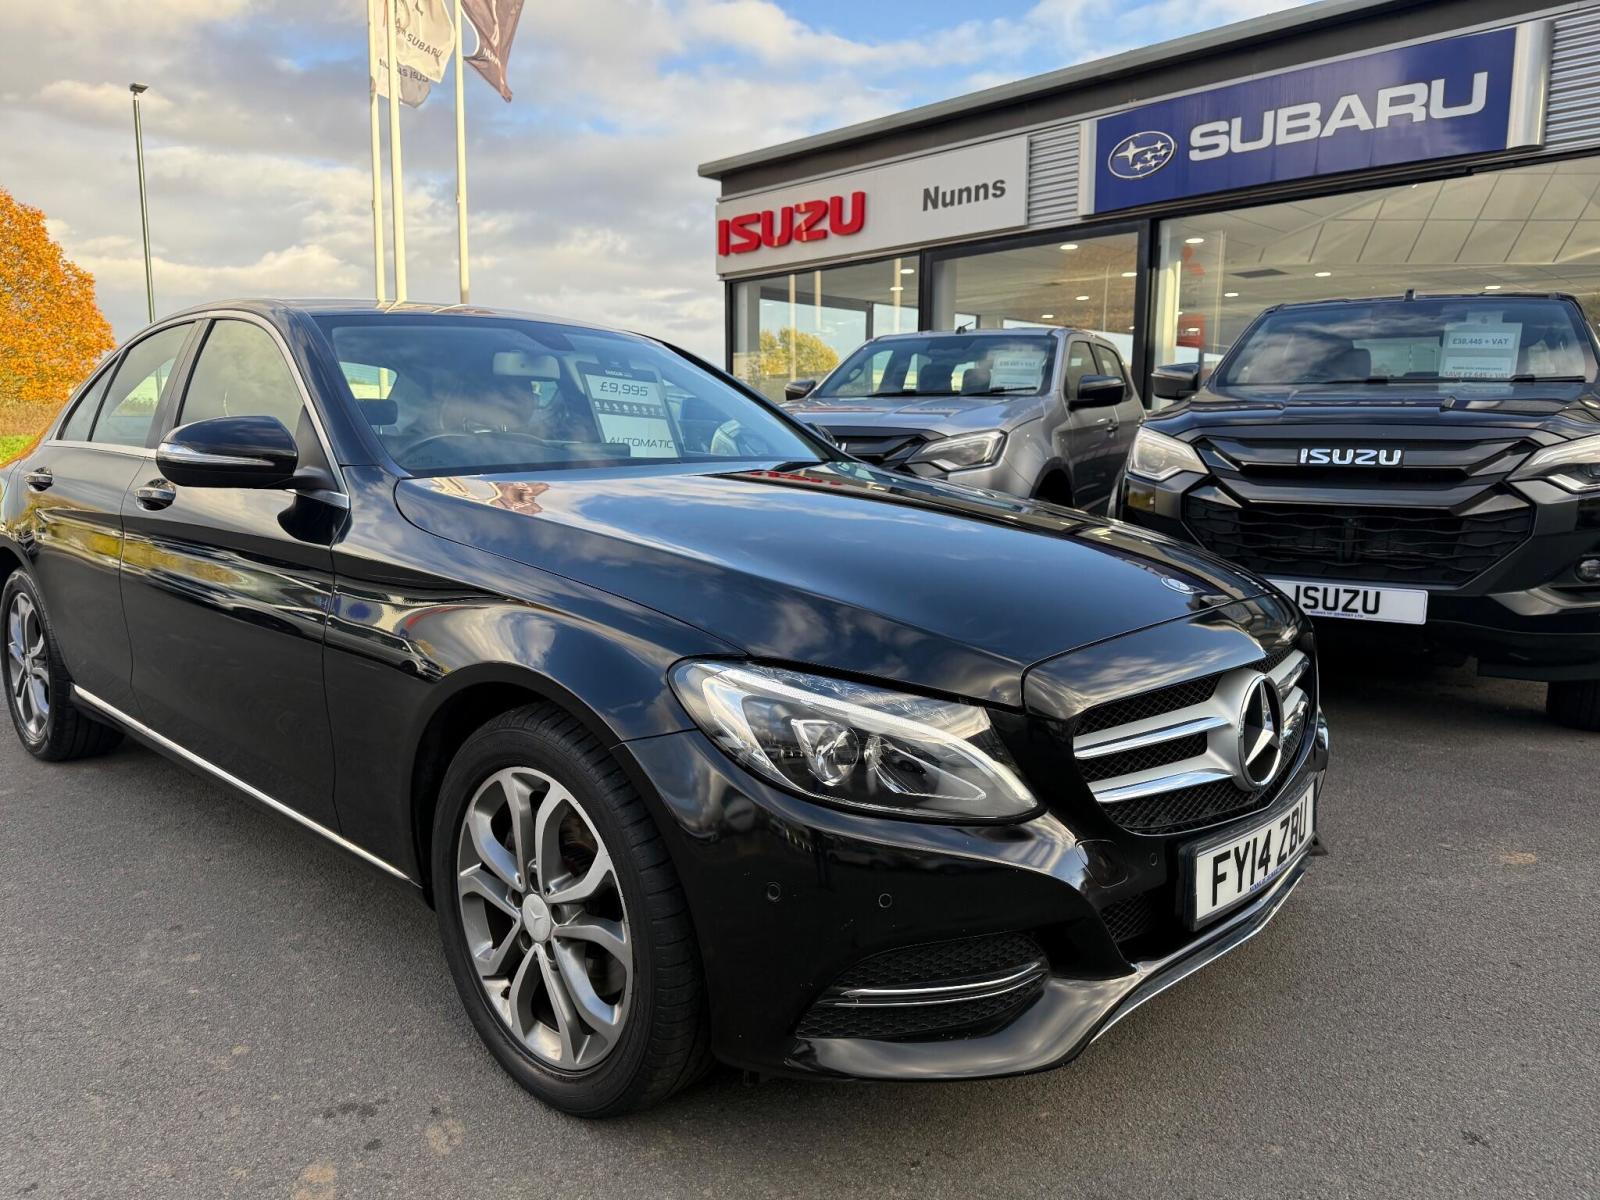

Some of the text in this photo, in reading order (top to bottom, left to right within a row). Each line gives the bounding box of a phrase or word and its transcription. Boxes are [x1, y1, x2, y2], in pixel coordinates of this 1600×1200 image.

[1189, 72, 1488, 162] SUBARU
[922, 179, 1006, 211] Nunns
[718, 191, 866, 256] ISUZU
[1491, 337, 1510, 345] VAT
[600, 381, 649, 397] £9,995
[609, 437, 674, 449] AUTOMATIC
[1299, 448, 1402, 466] ISUZU
[1294, 585, 1381, 615] ISUZU
[1211, 796, 1308, 907] FY14 ZBU
